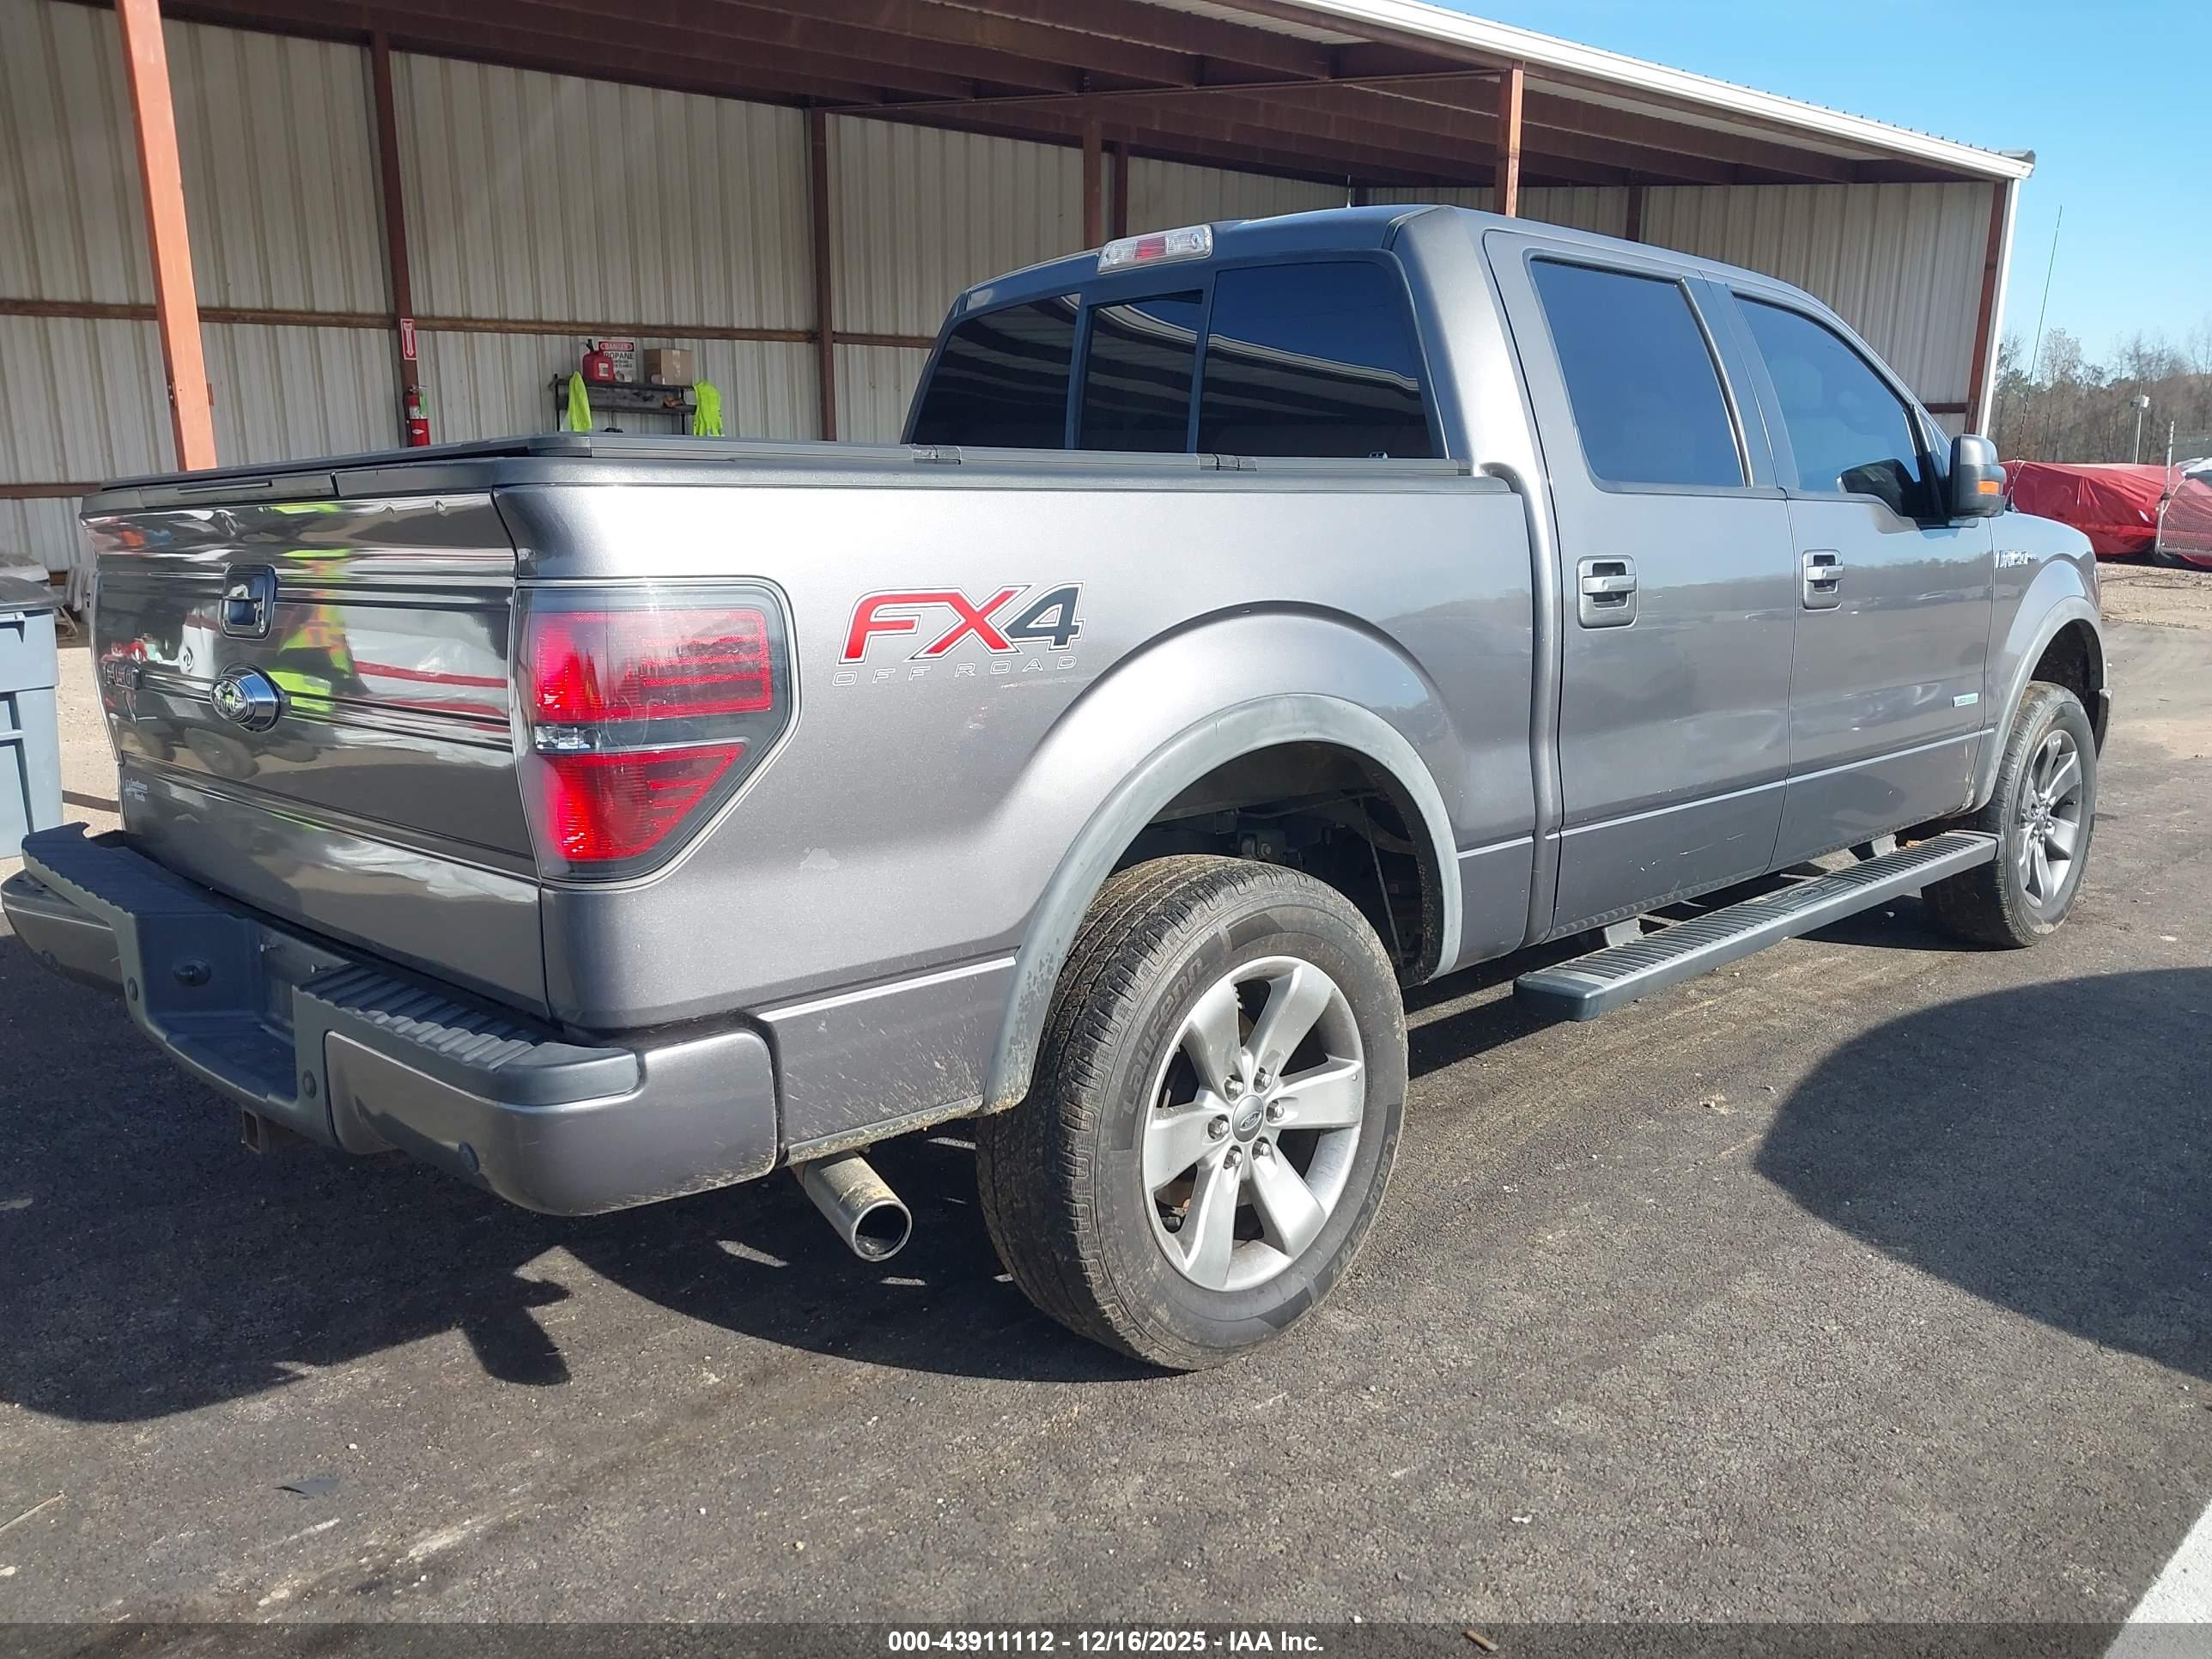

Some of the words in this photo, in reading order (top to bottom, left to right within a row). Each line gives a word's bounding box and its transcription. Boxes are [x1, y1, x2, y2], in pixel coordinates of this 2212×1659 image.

[836, 581, 1086, 665] FX4
[832, 665, 931, 685] OFF
[954, 655, 1078, 678] ROAD
